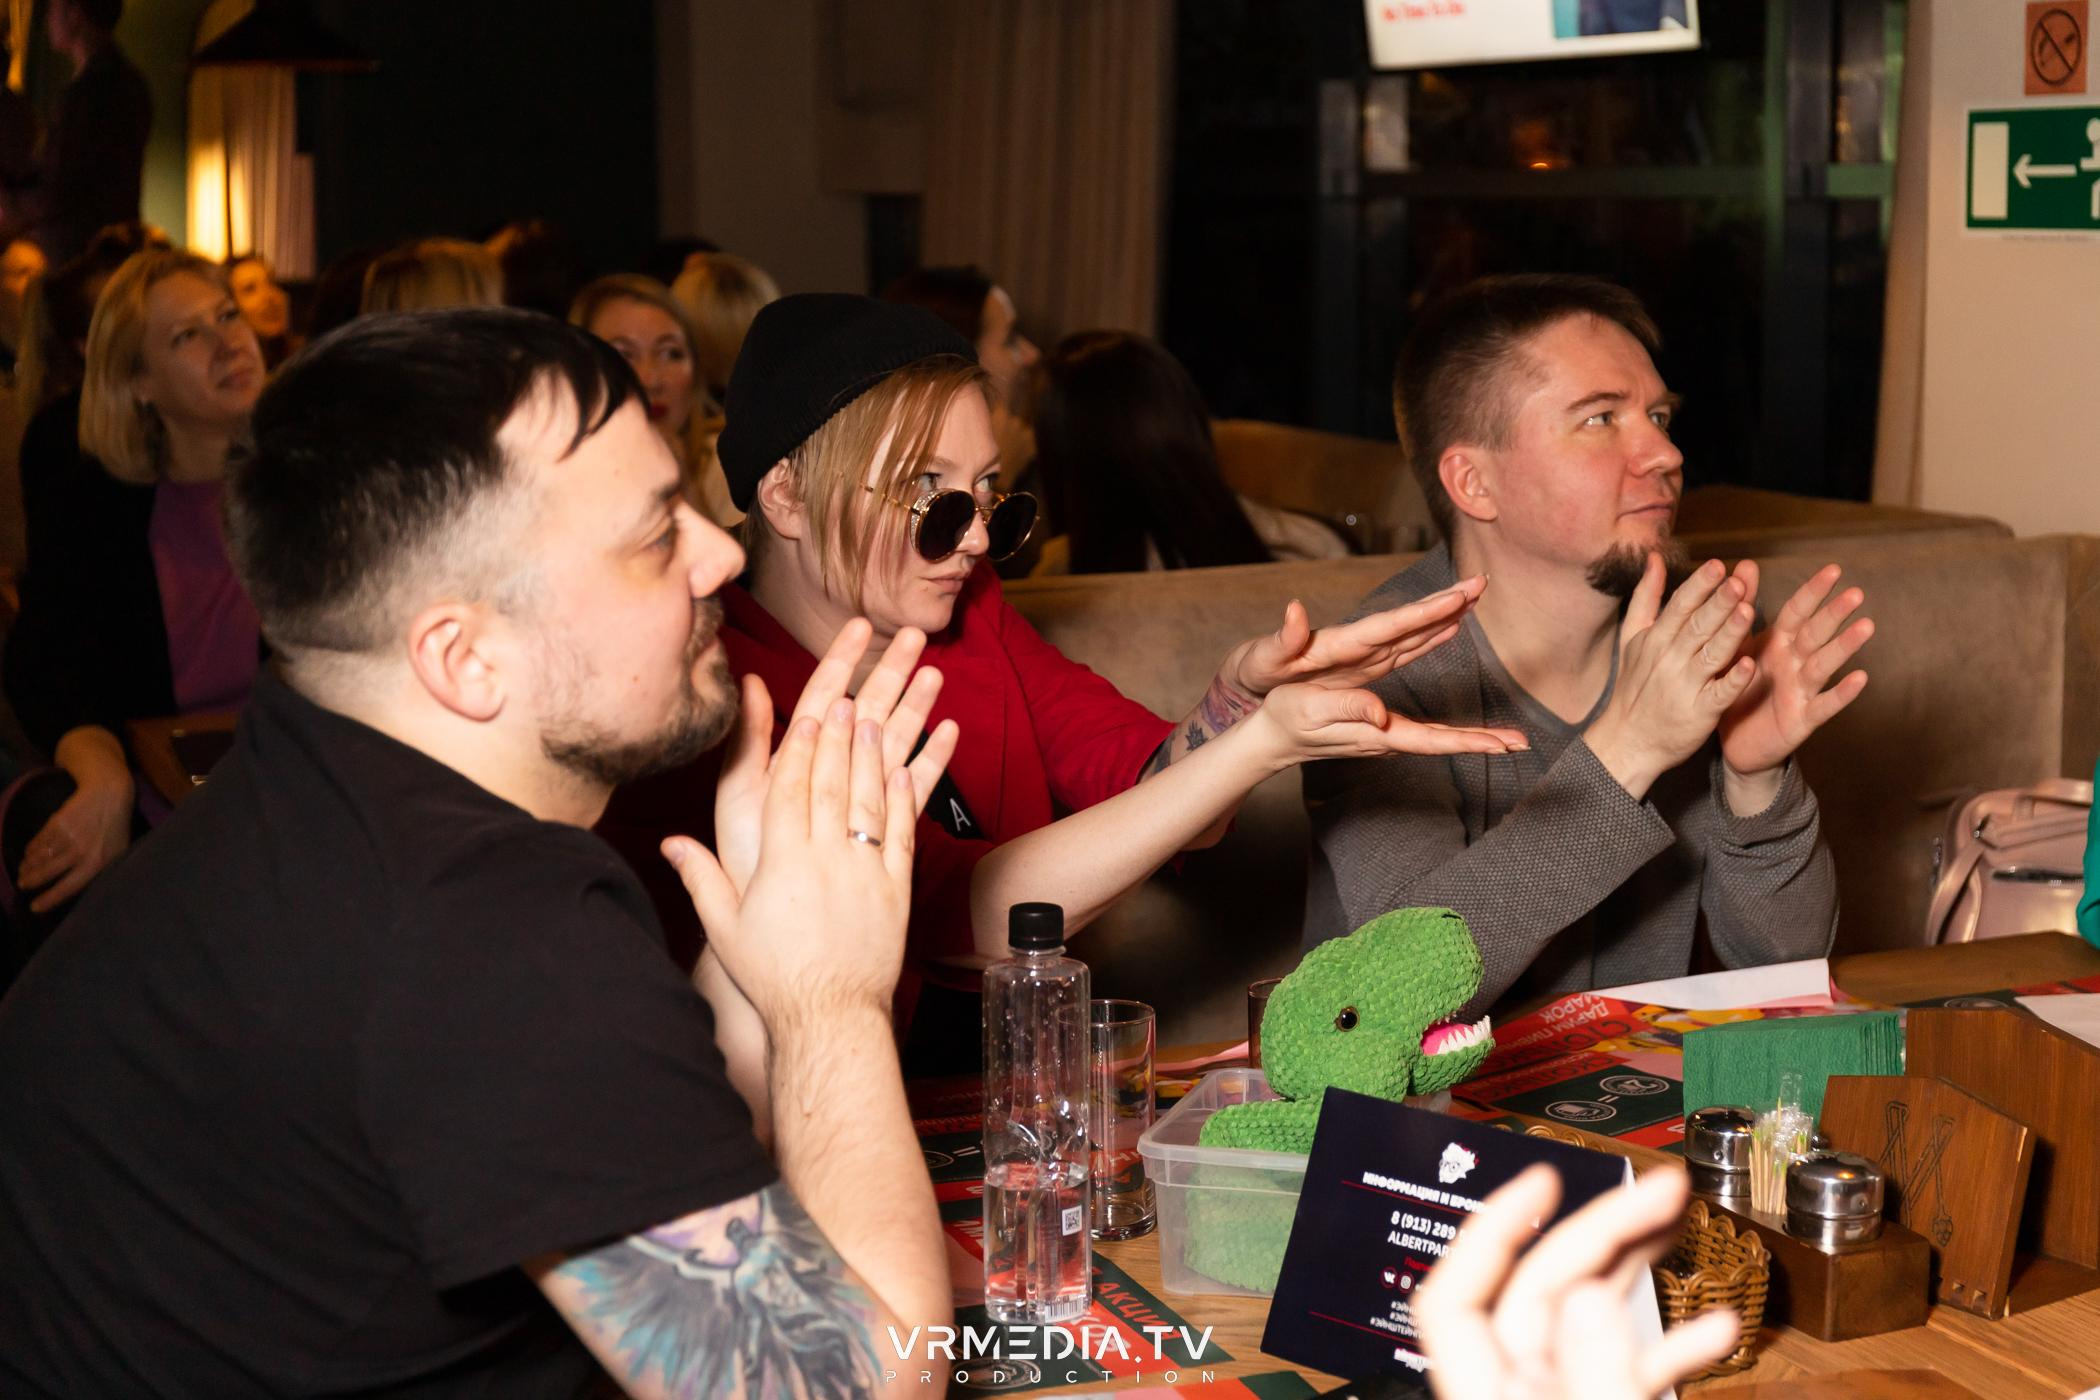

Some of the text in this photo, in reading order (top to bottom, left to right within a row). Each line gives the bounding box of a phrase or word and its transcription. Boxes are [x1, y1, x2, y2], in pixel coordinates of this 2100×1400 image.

[1552, 1000, 1610, 1033] ДАРИМ
[1391, 1210, 1400, 1225] 8
[1401, 1213, 1431, 1235] (913)
[1432, 1222, 1456, 1240] 289
